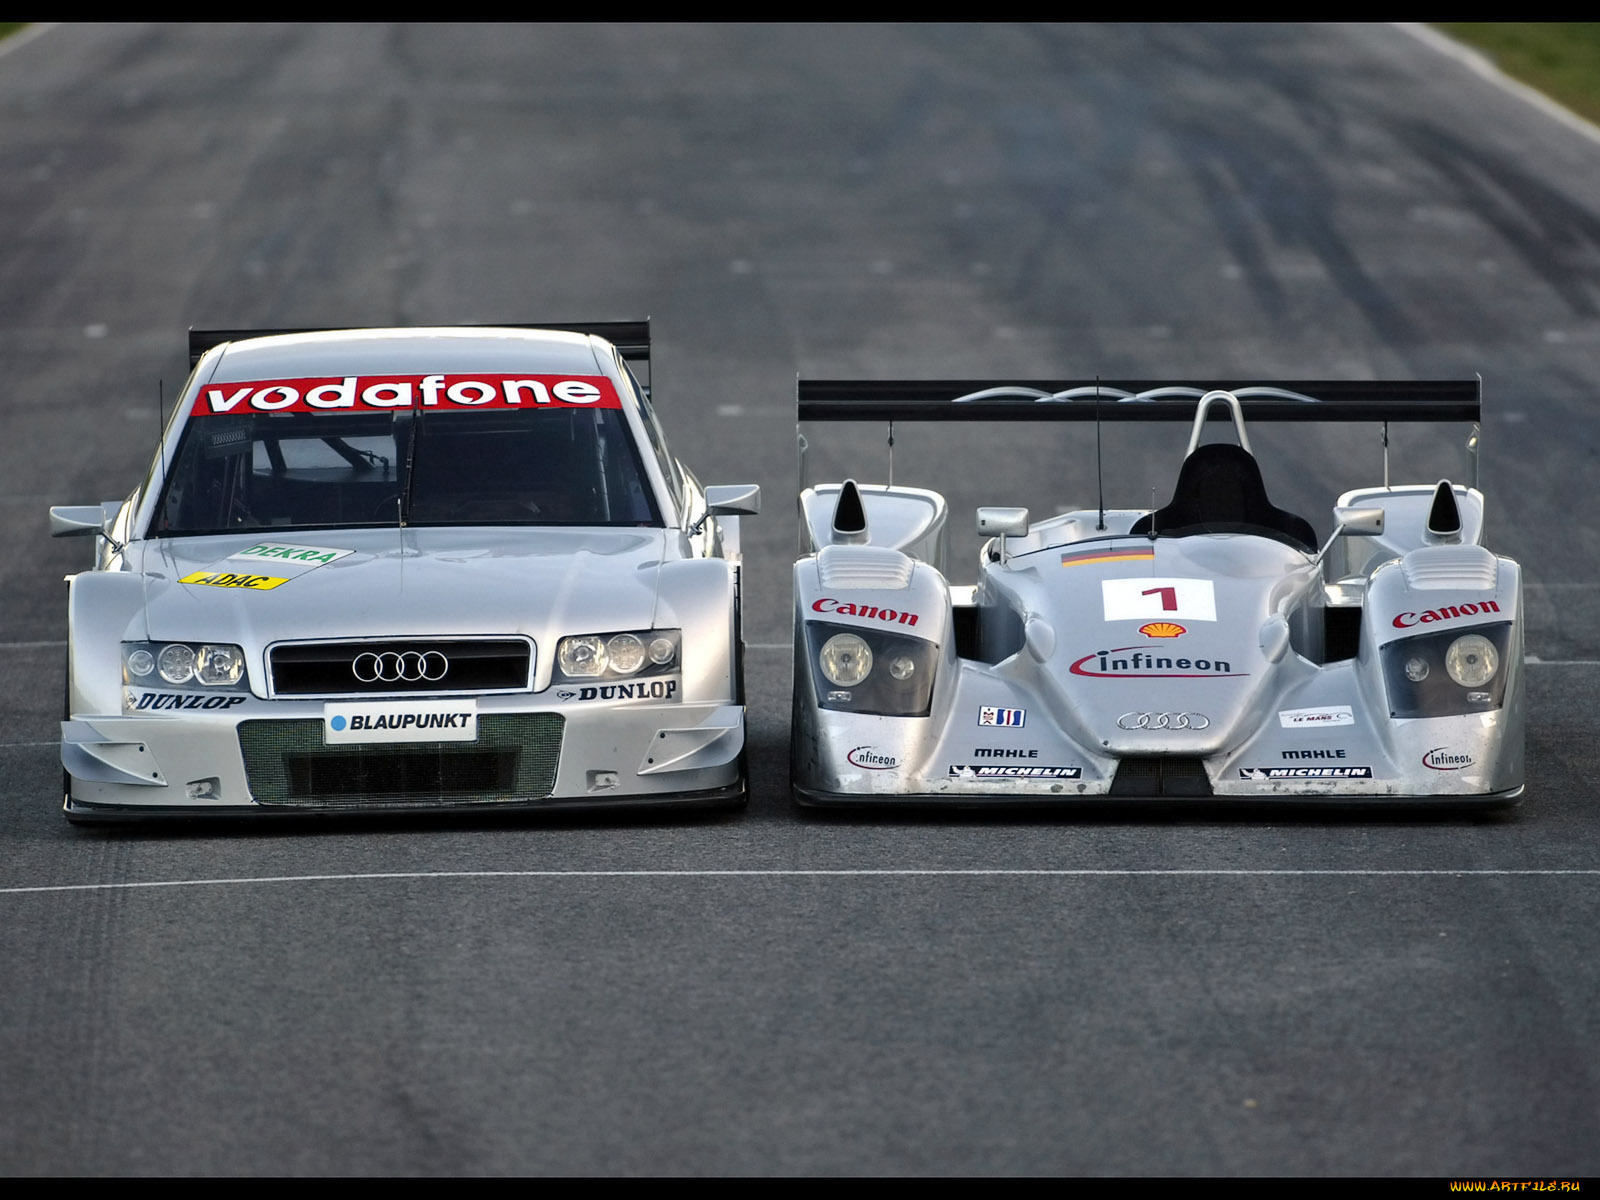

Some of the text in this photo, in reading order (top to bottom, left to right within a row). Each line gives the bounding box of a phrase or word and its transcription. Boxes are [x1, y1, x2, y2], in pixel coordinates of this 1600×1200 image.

[207, 375, 602, 413] vodafone
[240, 545, 337, 563] DEKRA
[195, 573, 269, 588] ADAC
[1141, 587, 1178, 611] 1
[812, 598, 919, 627] Canon
[1392, 600, 1501, 629] Canon
[578, 680, 677, 701] DUNLOP
[136, 693, 247, 710] DUNLOP
[350, 713, 472, 731] BLAUPUNKT
[974, 748, 1039, 758] MAHLE
[1281, 749, 1346, 760] MAHLE
[977, 767, 1077, 776] MICHELIN
[1268, 768, 1367, 777] MICHELIN
